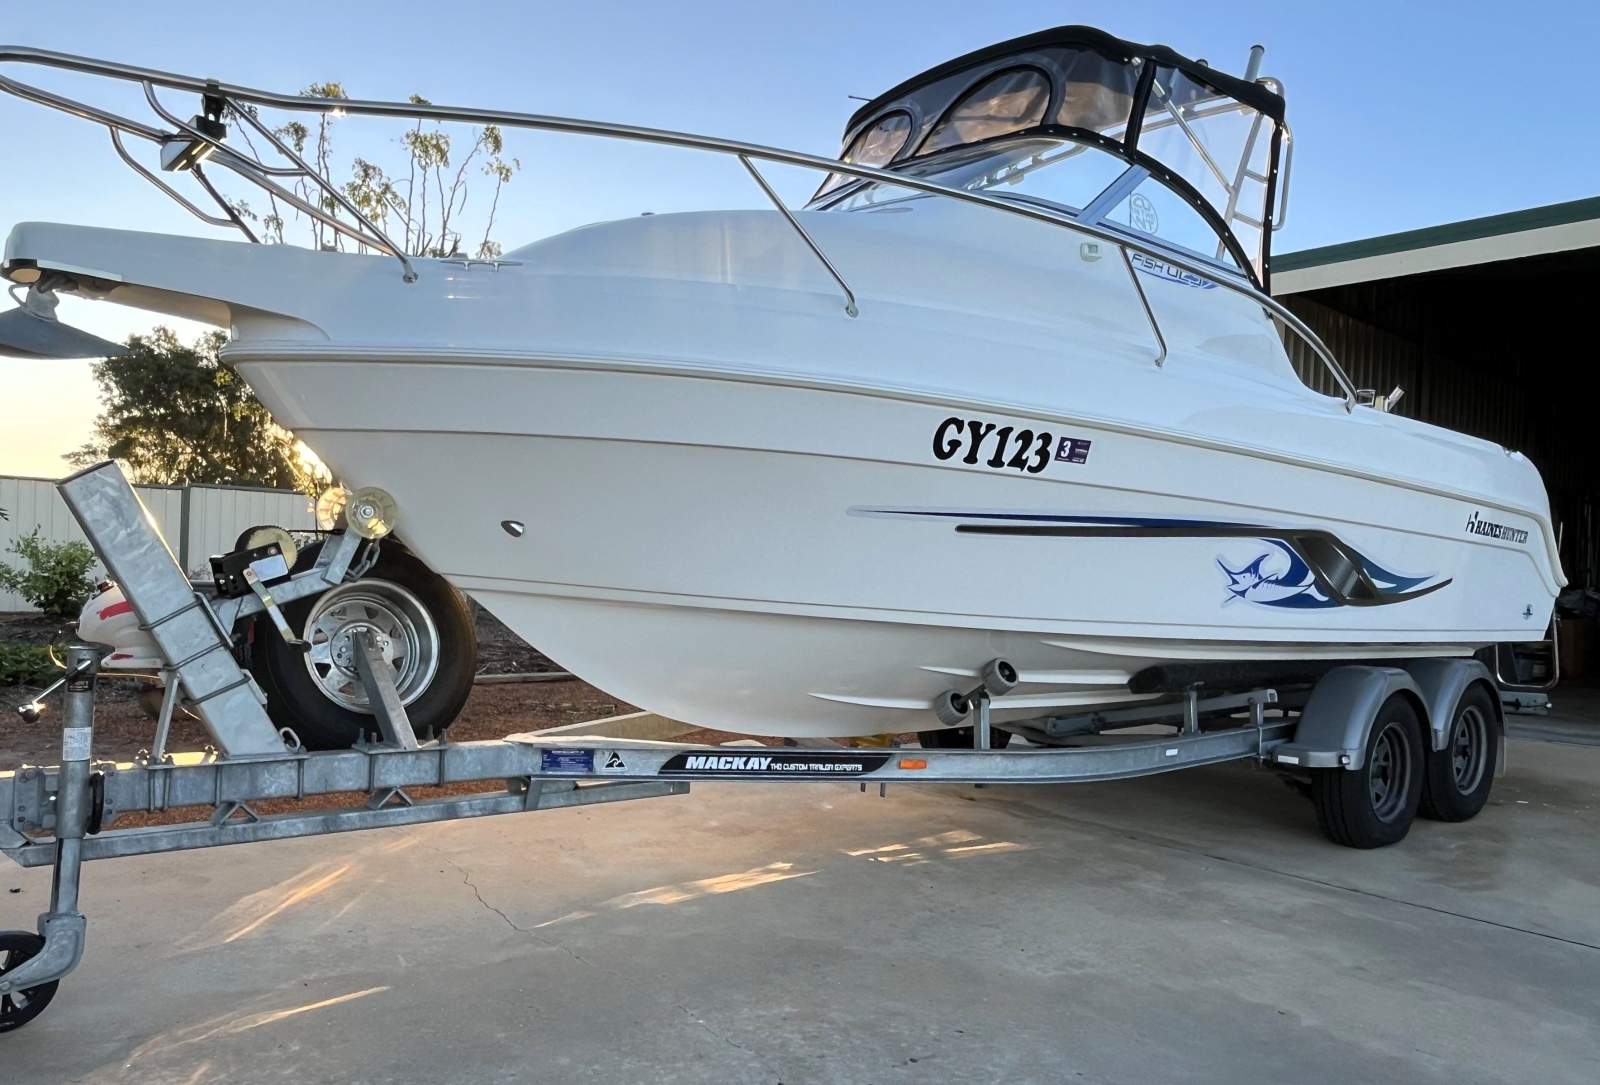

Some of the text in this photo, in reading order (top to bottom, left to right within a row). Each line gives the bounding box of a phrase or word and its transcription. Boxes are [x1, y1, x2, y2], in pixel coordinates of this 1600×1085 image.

[933, 417, 1052, 473] GY123
[1060, 440, 1071, 457] 3
[685, 756, 772, 770] MACKAY
[783, 763, 808, 771] CUSTOM
[809, 763, 834, 772] TRAILER
[834, 764, 863, 772] EXPERTS
